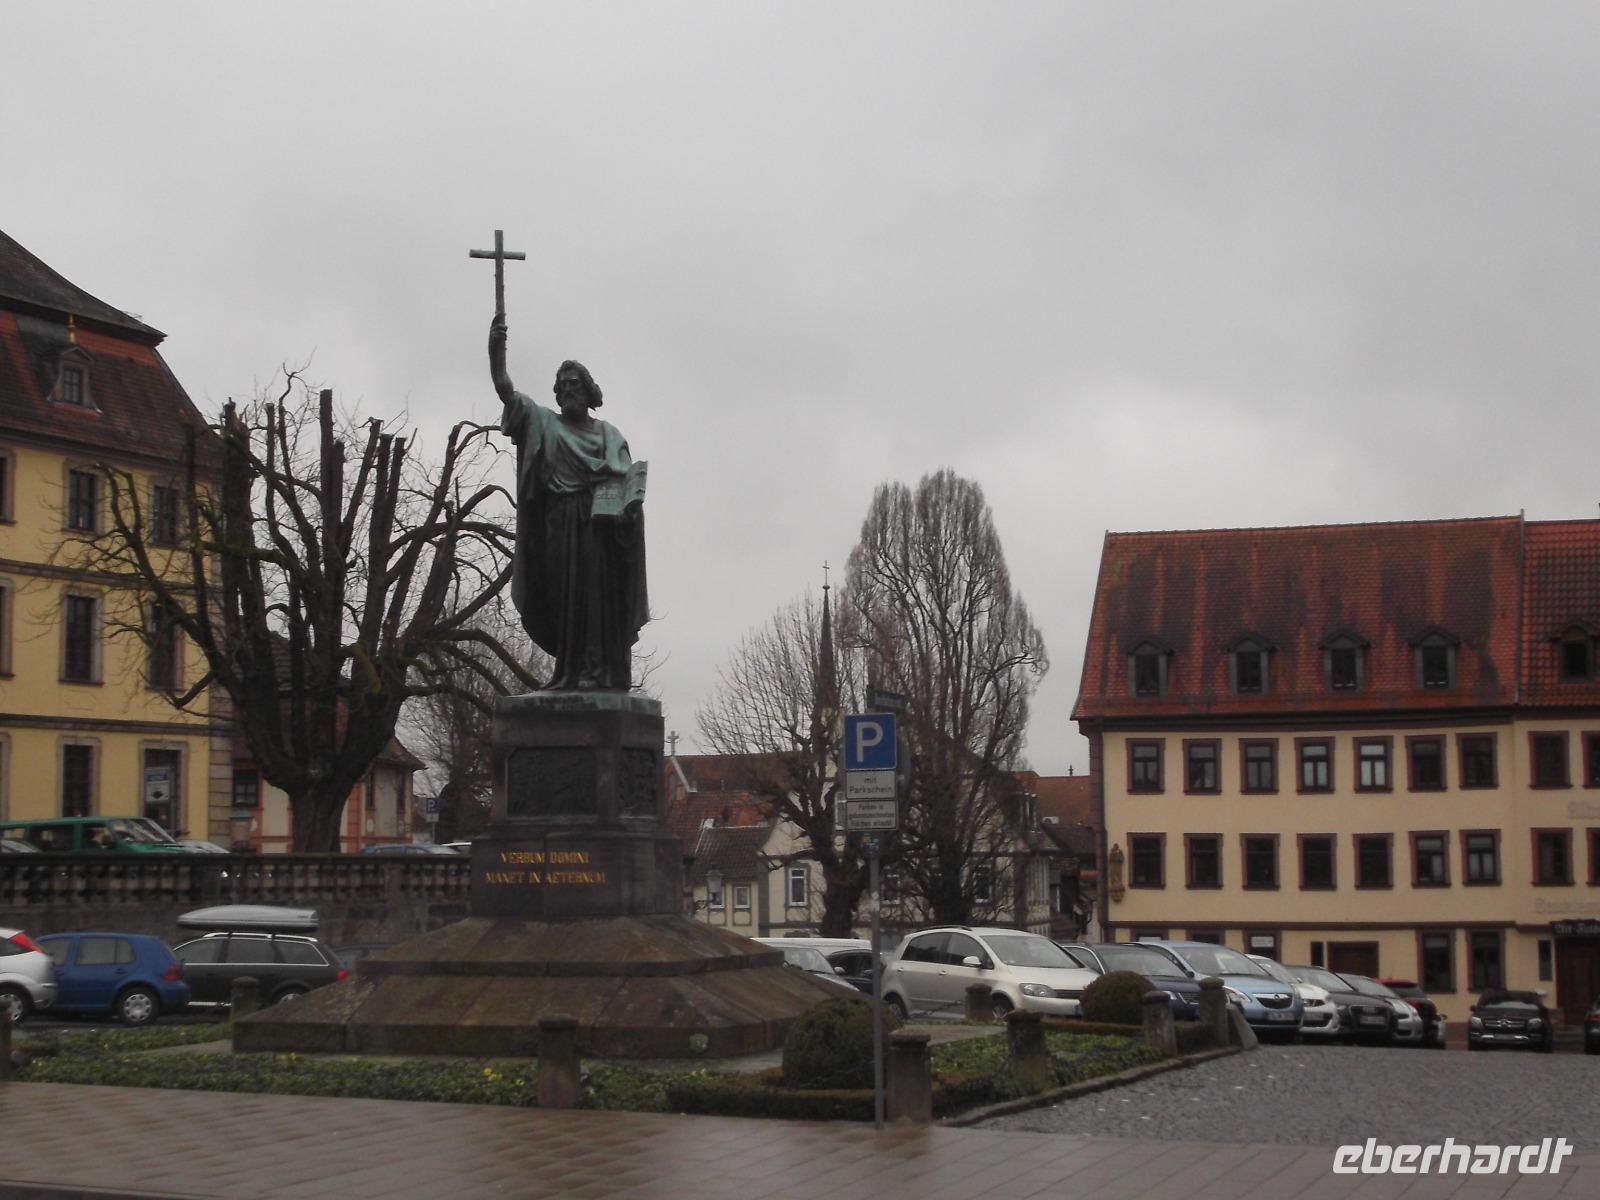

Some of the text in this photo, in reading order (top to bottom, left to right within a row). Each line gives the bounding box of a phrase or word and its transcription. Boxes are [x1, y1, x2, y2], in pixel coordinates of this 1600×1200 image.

[856, 721, 883, 763] P
[864, 775, 877, 784] mit
[849, 785, 894, 794] Parkschein
[501, 852, 589, 864] VERBUM DOMINI
[485, 871, 606, 884] MANET IN AETERNUM
